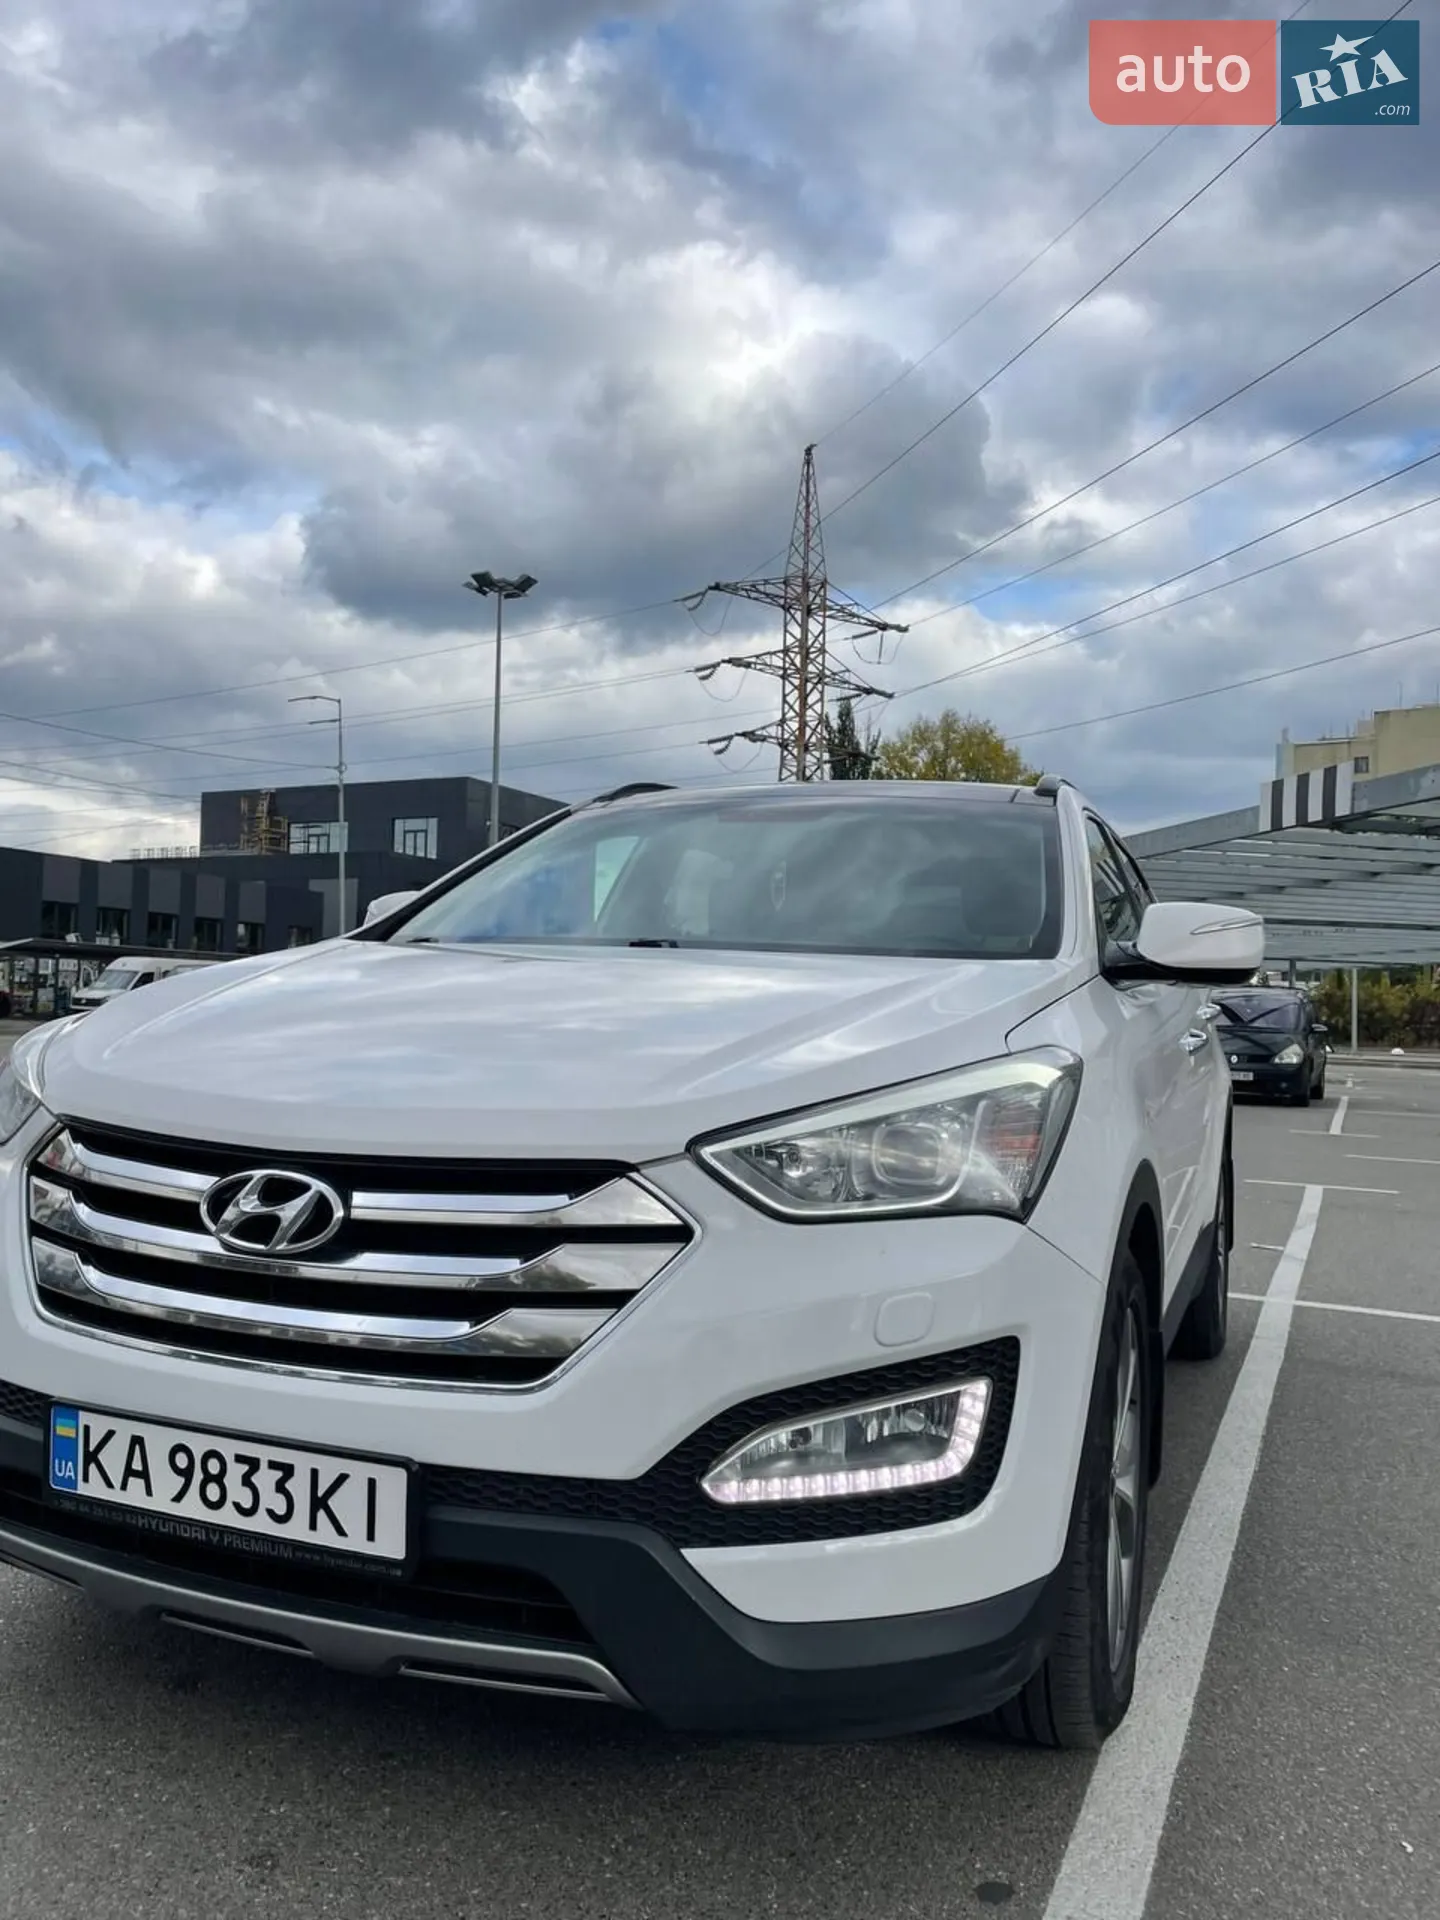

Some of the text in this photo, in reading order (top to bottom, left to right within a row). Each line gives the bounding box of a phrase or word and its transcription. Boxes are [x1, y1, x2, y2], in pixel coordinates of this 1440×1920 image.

[55, 1459, 75, 1480] UA
[137, 1514, 206, 1542] HYUNDAI
[223, 1533, 293, 1559] PREMIUM
